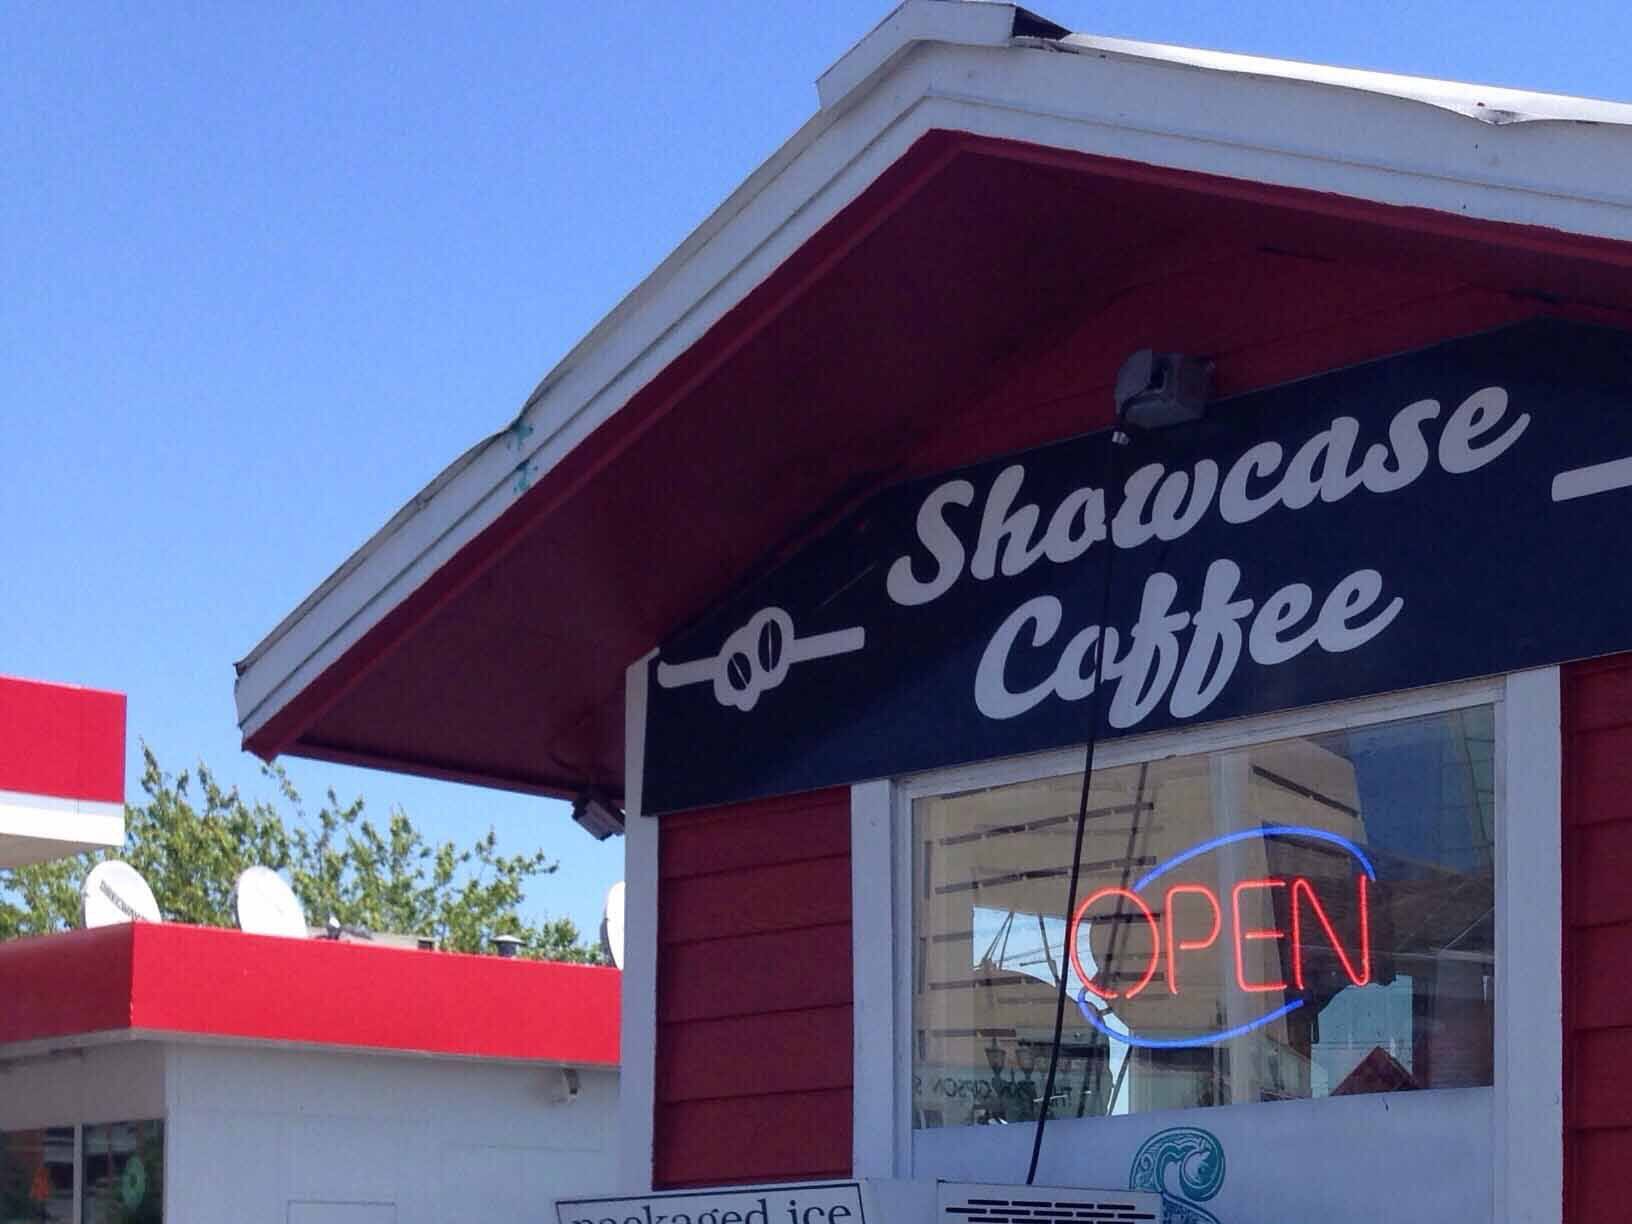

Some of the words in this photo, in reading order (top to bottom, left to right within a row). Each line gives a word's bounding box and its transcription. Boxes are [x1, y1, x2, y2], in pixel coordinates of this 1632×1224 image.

[887, 386, 1530, 606] Showcase
[973, 558, 1402, 728] Coffee
[1070, 874, 1370, 999] OPEN
